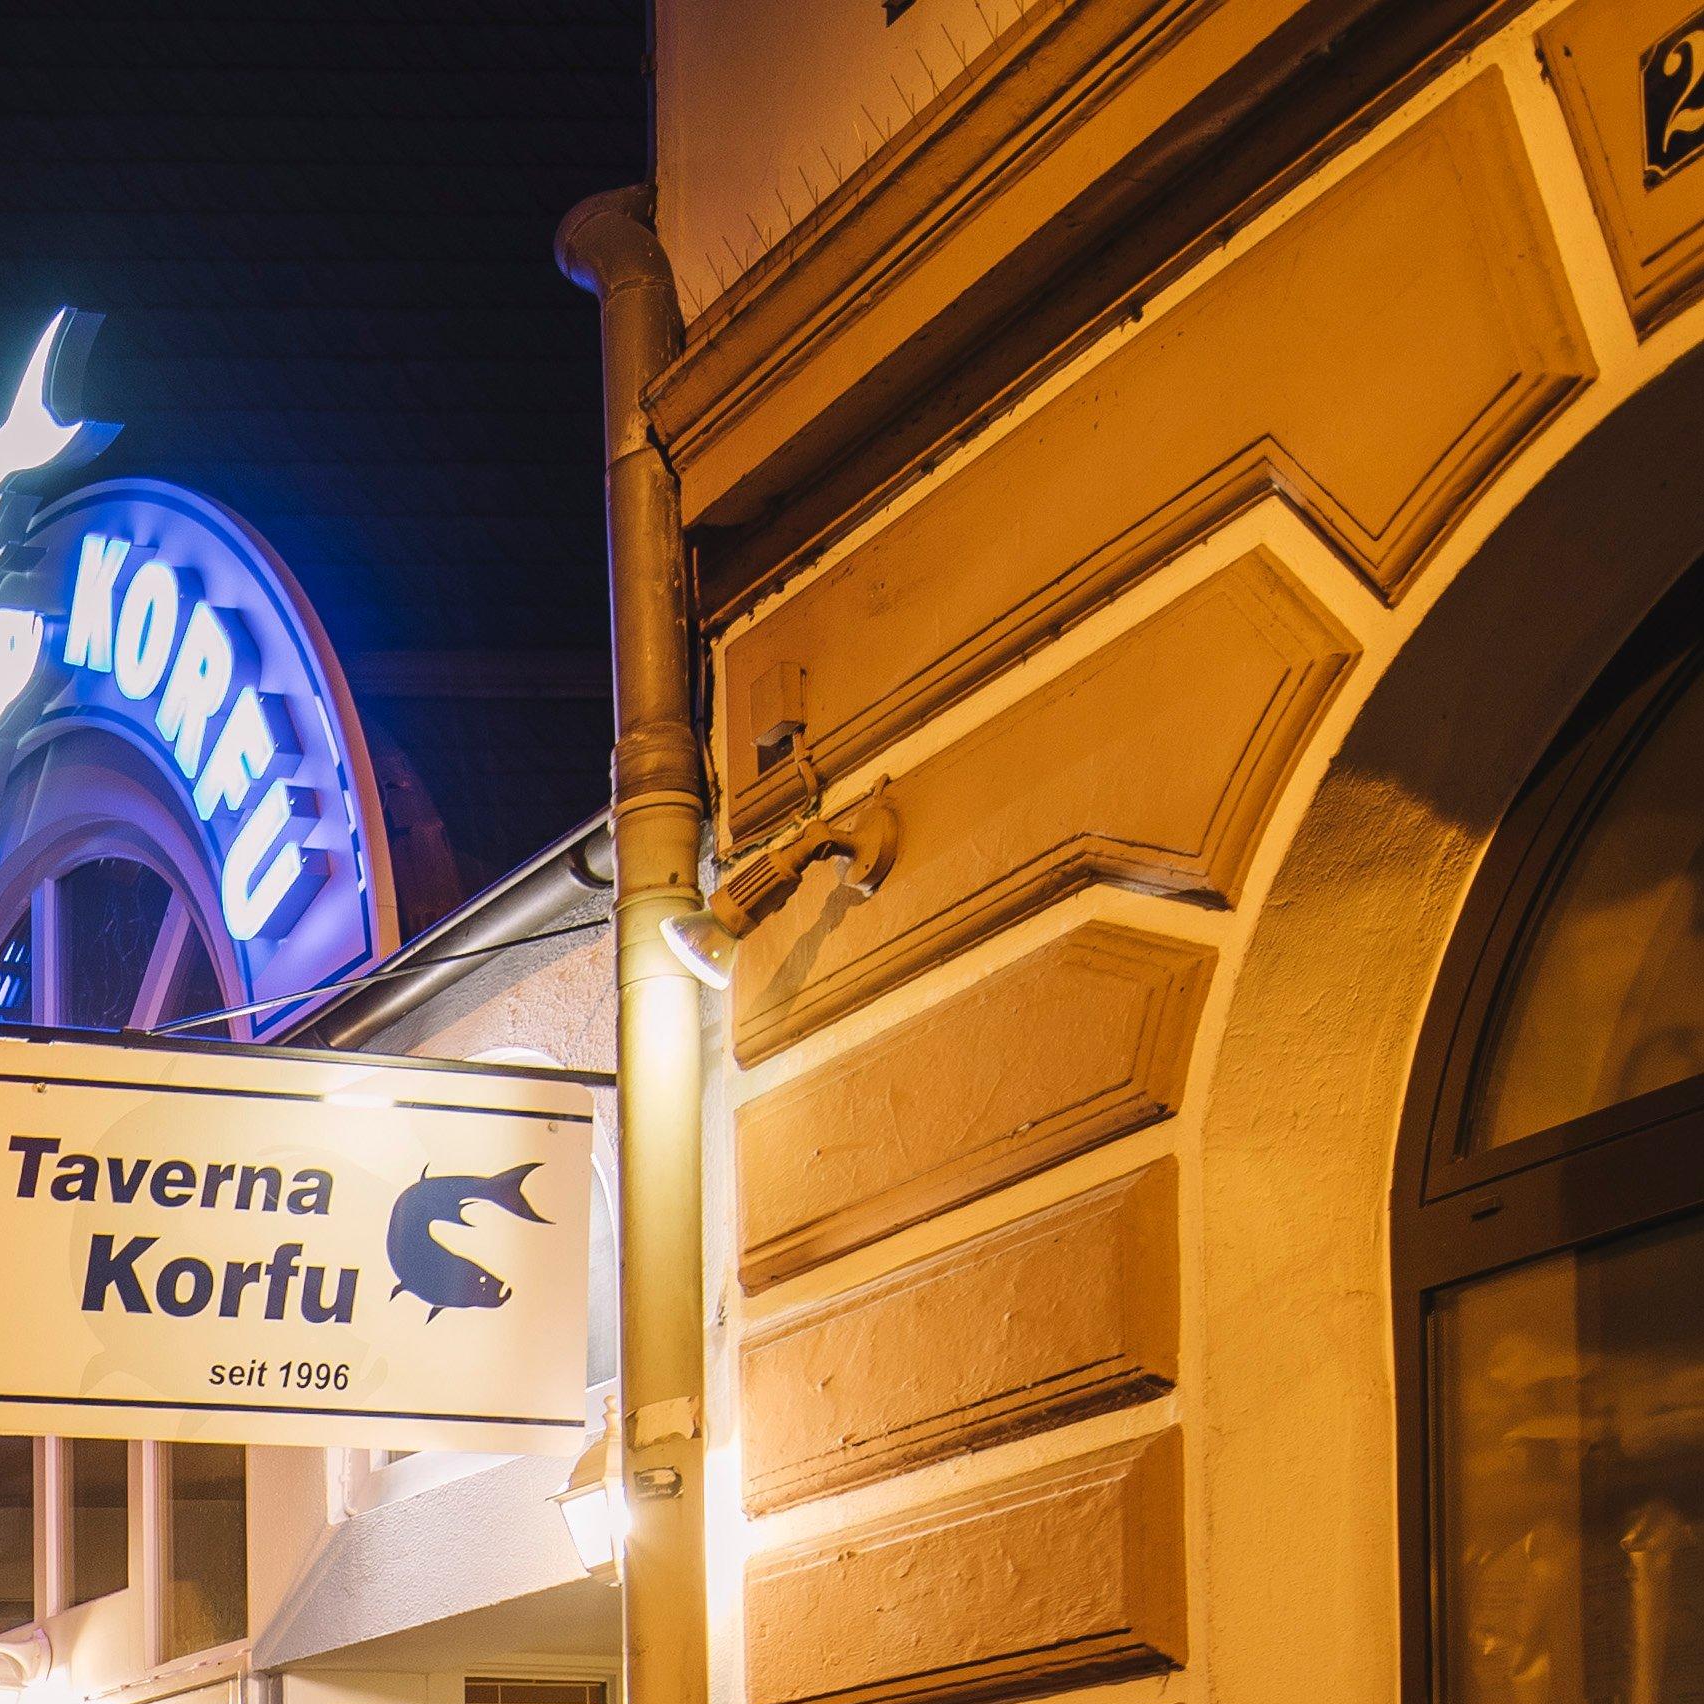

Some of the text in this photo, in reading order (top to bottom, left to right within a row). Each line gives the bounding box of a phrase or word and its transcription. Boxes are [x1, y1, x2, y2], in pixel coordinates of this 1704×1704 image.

[61, 531, 307, 942] KORFU
[8, 1135, 332, 1215] Taverna
[81, 1233, 359, 1324] Korfu
[208, 1358, 350, 1391] seit 1996
